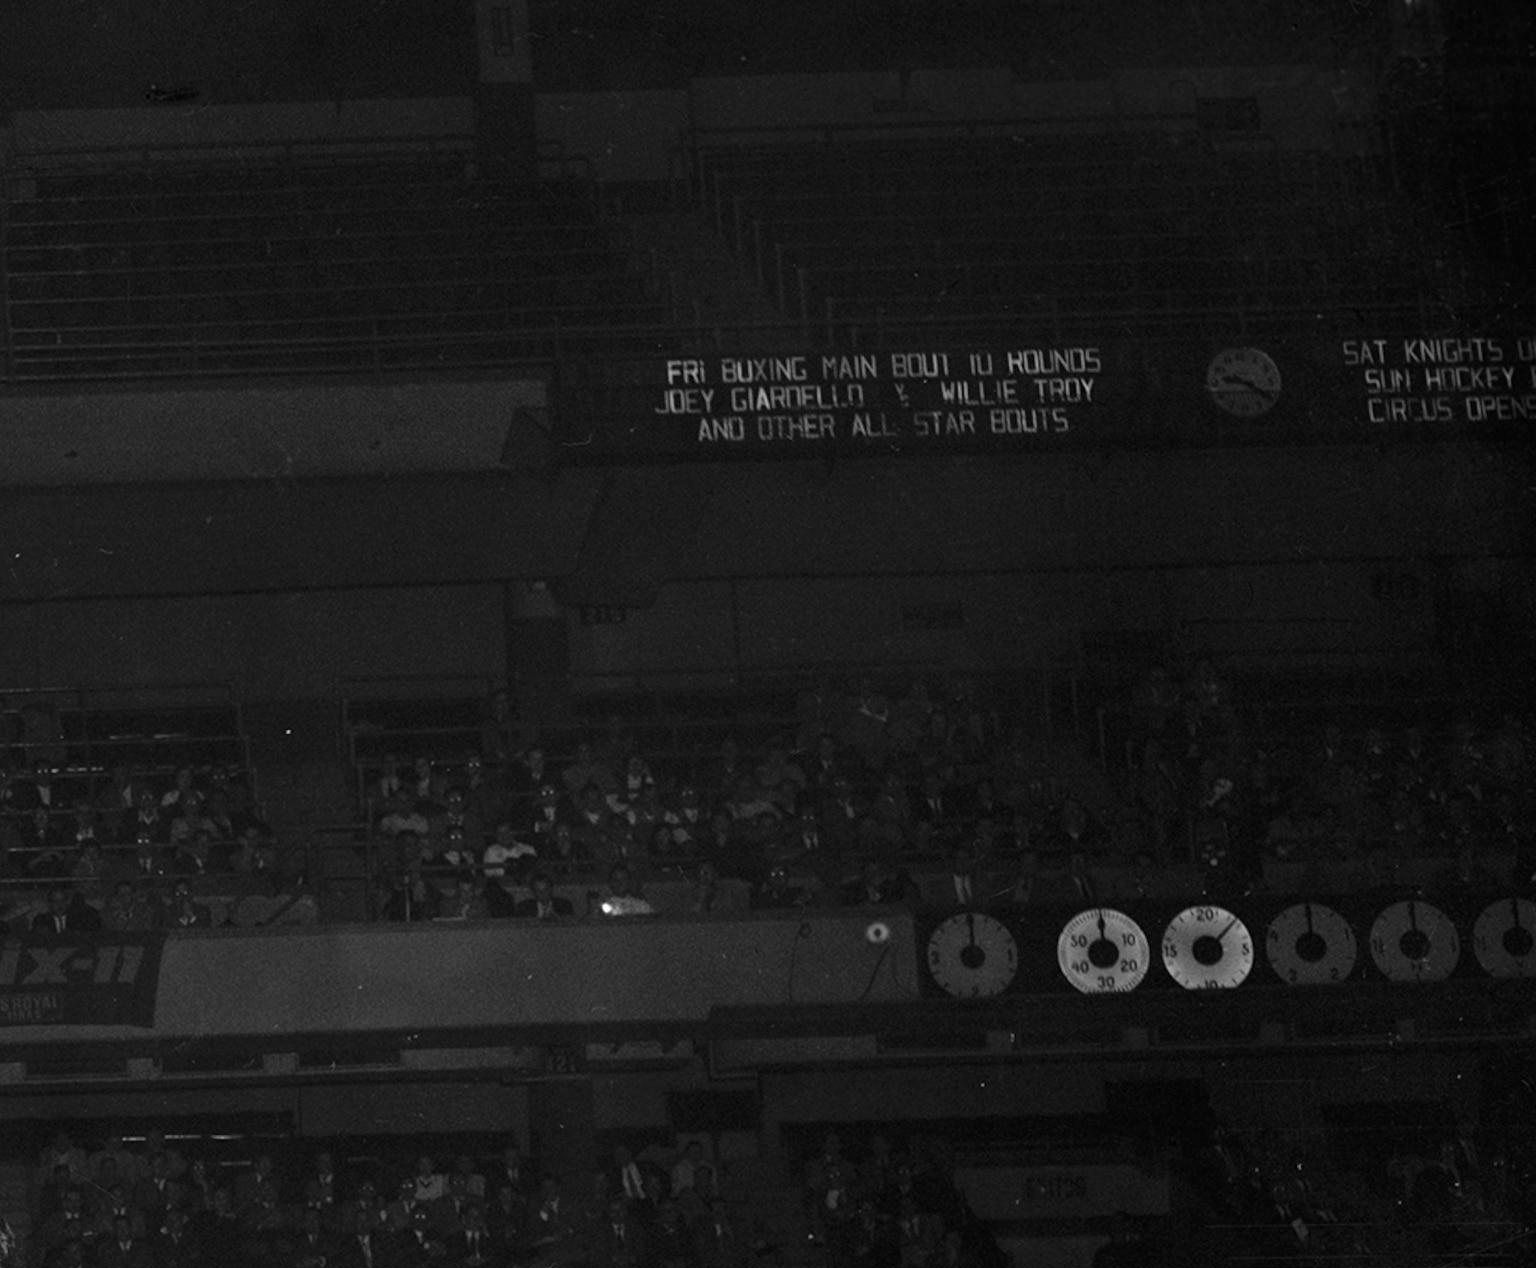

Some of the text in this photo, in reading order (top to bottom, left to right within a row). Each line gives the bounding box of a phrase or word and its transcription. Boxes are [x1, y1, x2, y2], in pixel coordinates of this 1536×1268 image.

[822, 354, 878, 380] MAIN
[1007, 347, 1102, 374] ROUNDS
[1342, 339, 1388, 366] SAT
[1404, 338, 1504, 364] KNIGHTS
[1365, 368, 1412, 395] SUN
[1425, 366, 1515, 393] HOCKEY
[654, 388, 715, 414] JOEY
[731, 383, 864, 412] GIARDELLO
[940, 379, 1020, 406] WILLIE
[1033, 377, 1094, 403] TROY
[1367, 396, 1453, 423] CIRCUS
[698, 406, 1070, 442] AND OTHER ALL STAR BOUTS
[1196, 908, 1214, 922] 20
[1070, 934, 1136, 948] 50 10
[1163, 944, 1250, 958] 15 5
[1071, 959, 1138, 975] 40 20
[1096, 975, 1115, 989] 30
